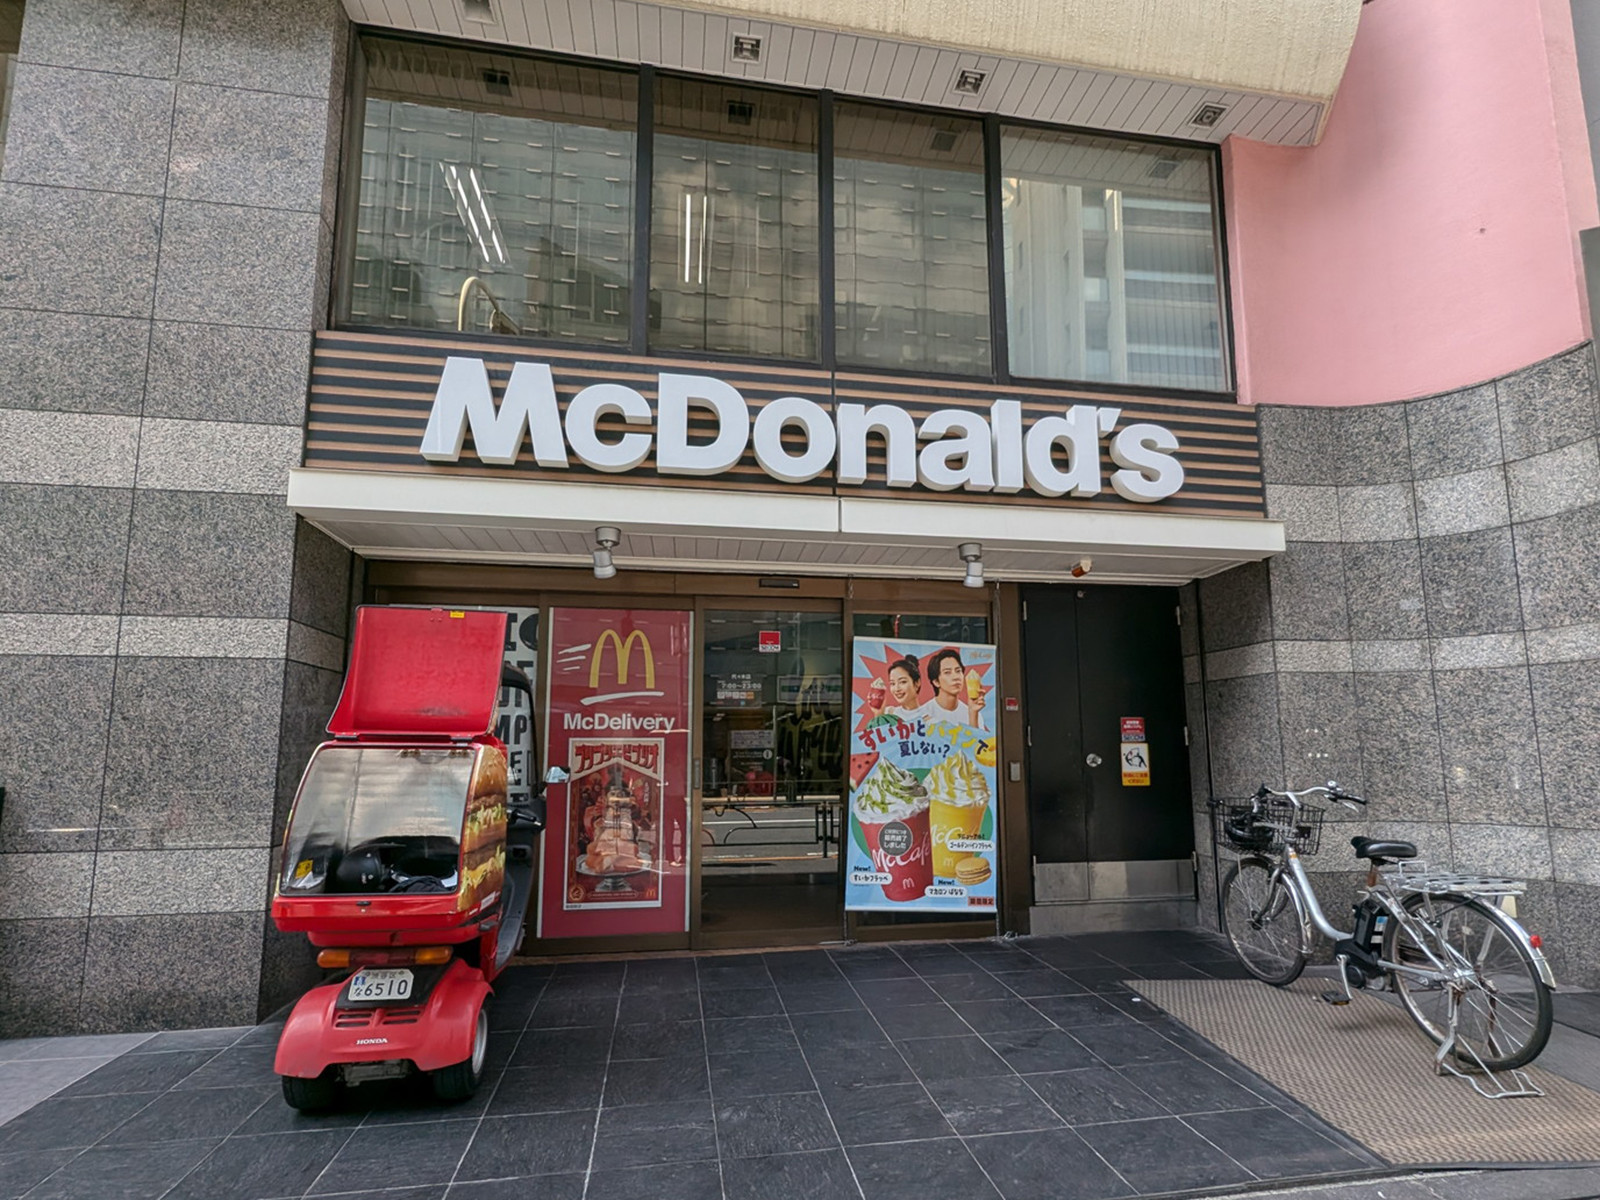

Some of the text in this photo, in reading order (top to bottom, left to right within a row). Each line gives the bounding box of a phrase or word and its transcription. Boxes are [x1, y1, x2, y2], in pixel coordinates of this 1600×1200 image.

[419, 356, 1185, 502] McDonald's
[563, 712, 675, 733] McDelivery
[858, 719, 989, 755] すいかとパインで
[364, 979, 408, 996] 6510
